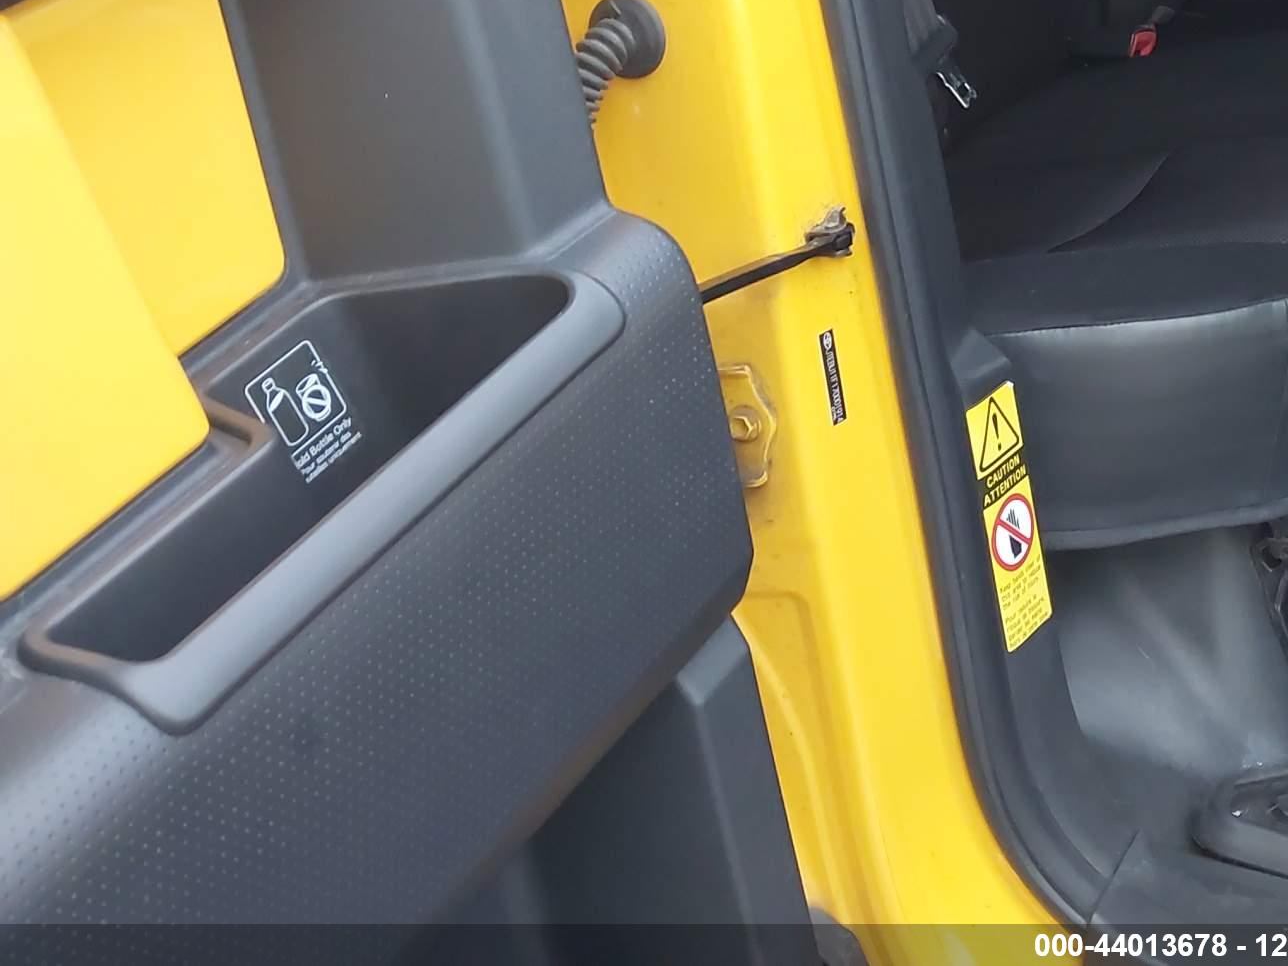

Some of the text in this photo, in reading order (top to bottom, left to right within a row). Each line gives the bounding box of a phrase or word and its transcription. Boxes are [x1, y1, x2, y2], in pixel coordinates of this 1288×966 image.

[309, 433, 334, 456] Bottle
[333, 417, 351, 435] Only
[984, 464, 1027, 507] ATTENTION
[987, 455, 1019, 489] CAUTION
